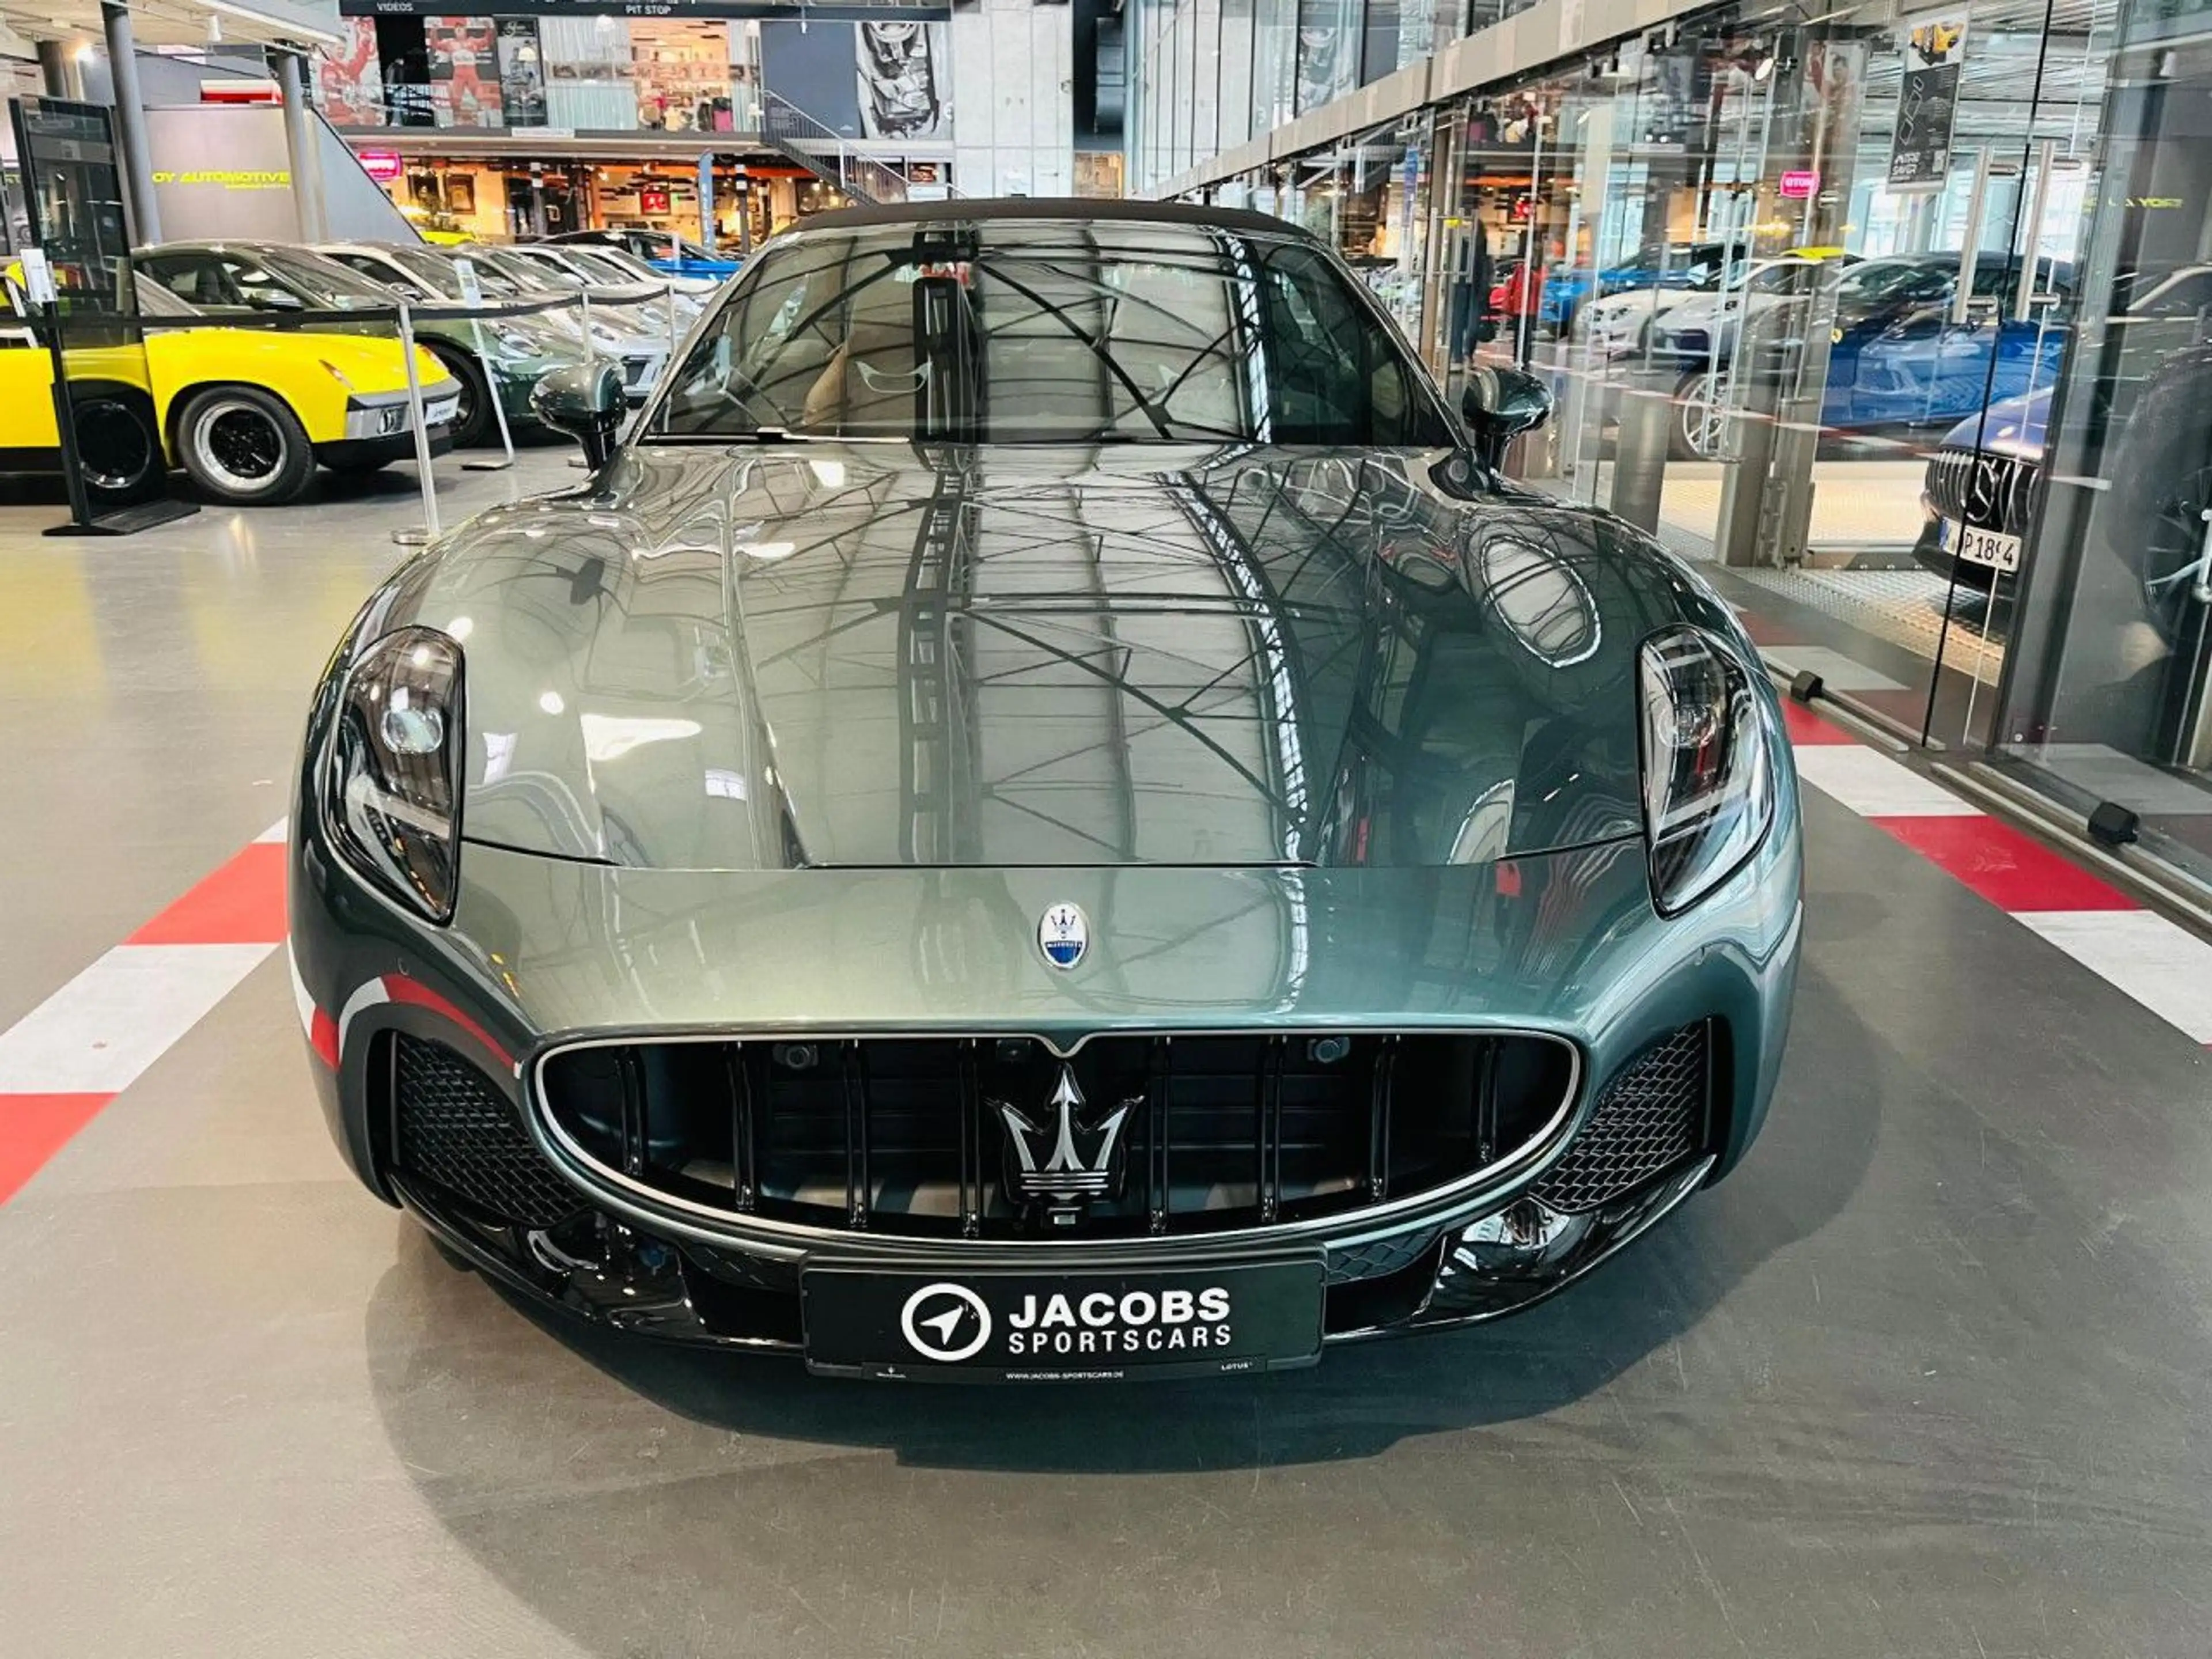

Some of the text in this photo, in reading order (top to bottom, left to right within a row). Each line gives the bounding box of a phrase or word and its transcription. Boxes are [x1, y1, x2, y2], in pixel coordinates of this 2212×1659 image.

[377, 2, 414, 12] VIDEOS
[625, 5, 672, 14] PIT STOP
[180, 172, 289, 183] AUTOMOTIVE
[1009, 1287, 1230, 1328] JACOBS
[1009, 1324, 1231, 1354] SPORTSCARS
